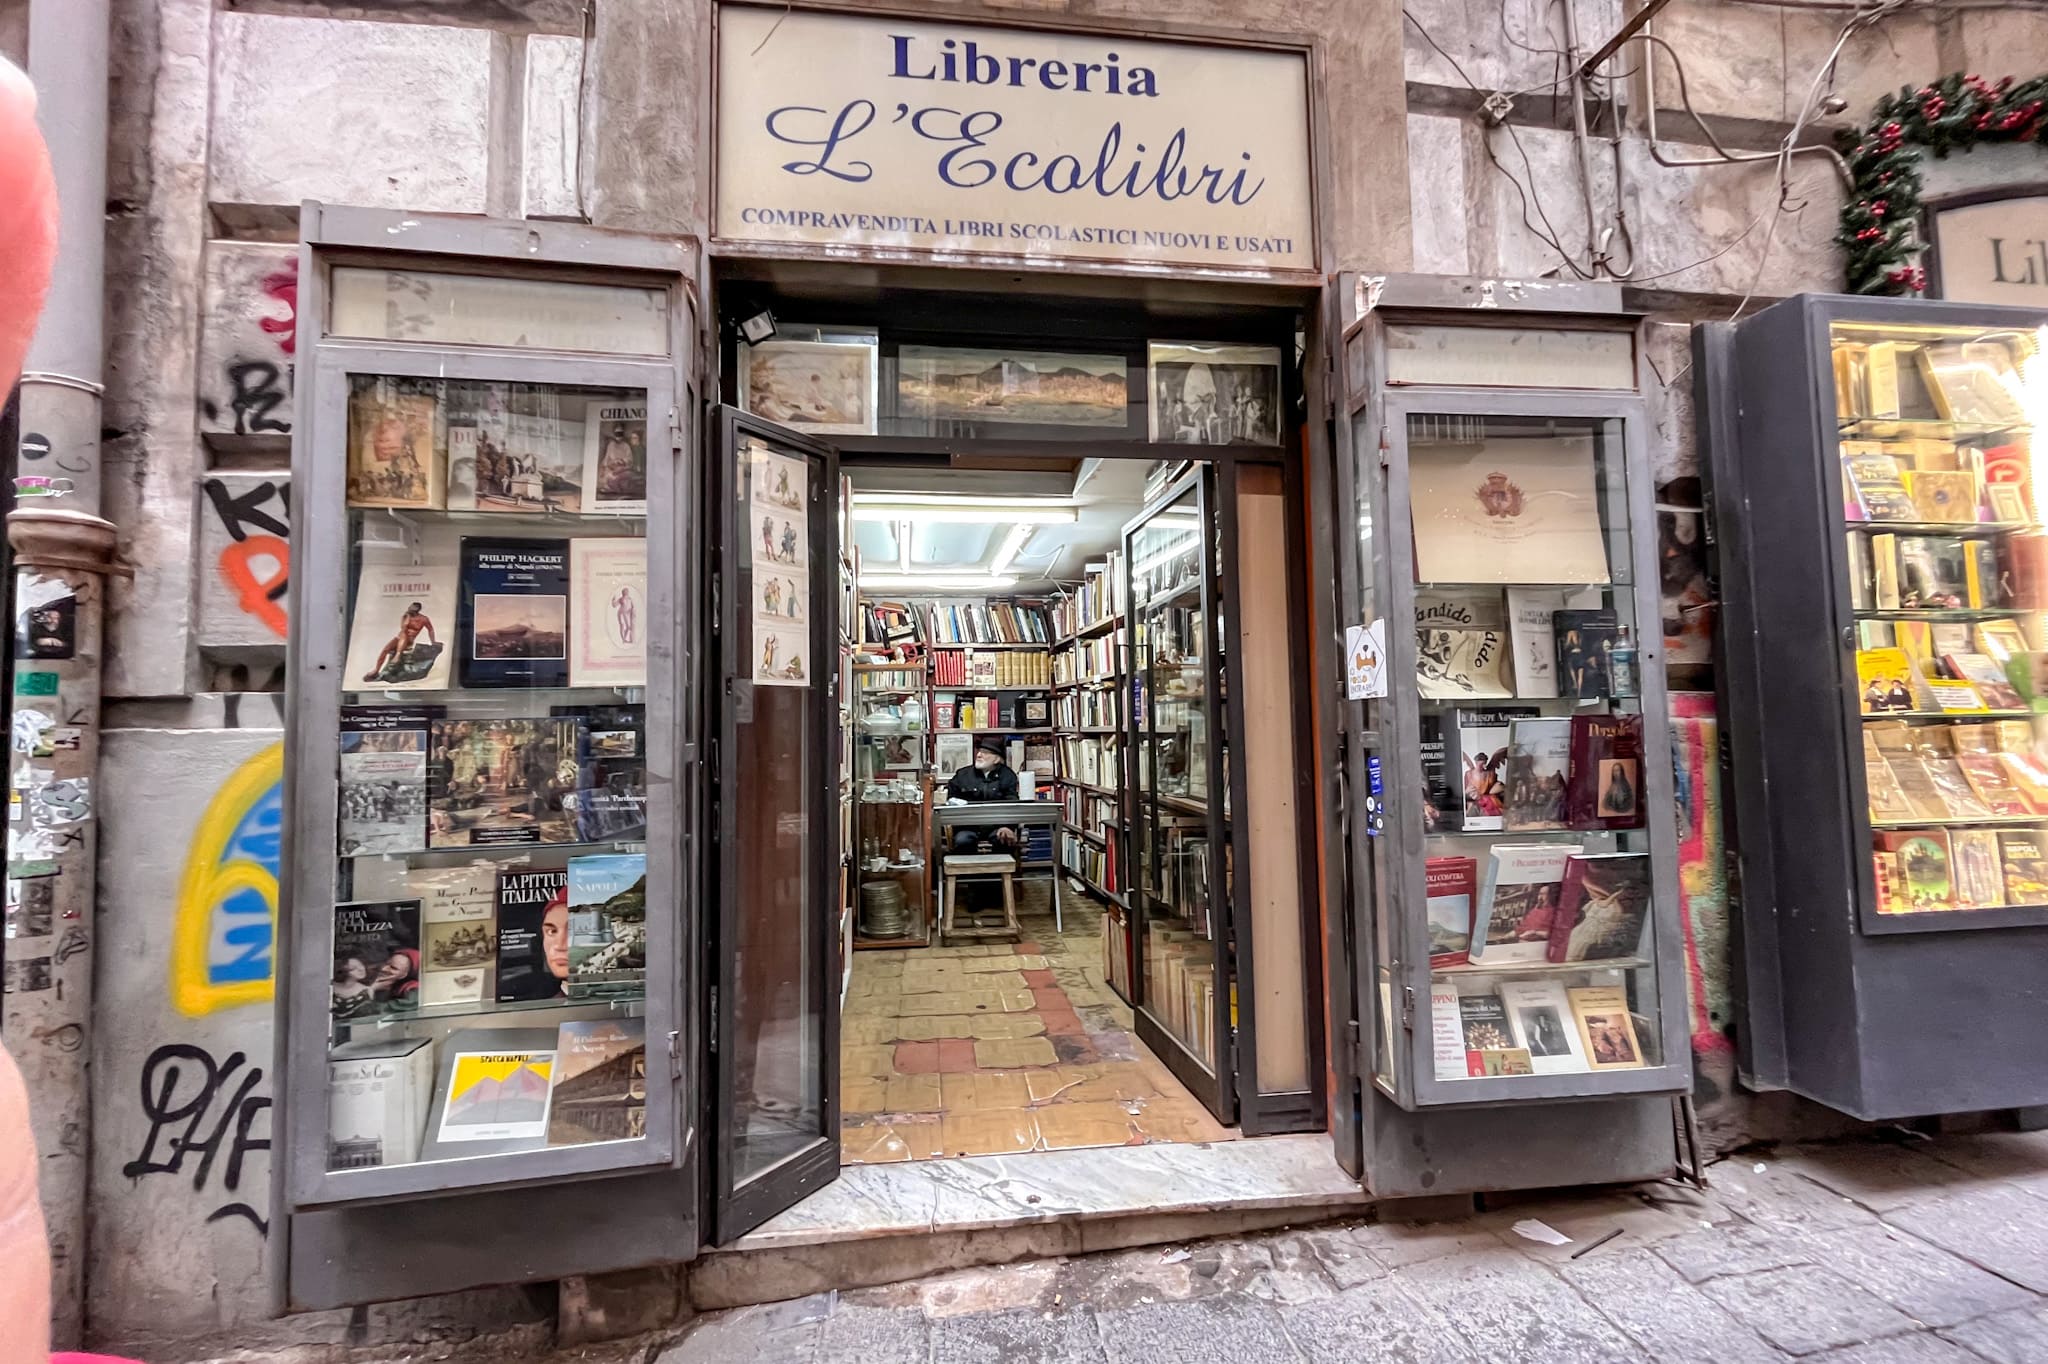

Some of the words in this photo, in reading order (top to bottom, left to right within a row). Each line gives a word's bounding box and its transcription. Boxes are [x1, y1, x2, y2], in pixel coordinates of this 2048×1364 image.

[888, 34, 1159, 97] Libreria
[765, 99, 1265, 206] L'Ecolibri
[741, 207, 937, 234] COMPRAVENDITA
[944, 219, 1004, 239] LIBRI
[1010, 223, 1137, 246] SCOLASTICI
[1144, 231, 1210, 250] NUOVI
[1216, 235, 1229, 251] E
[1235, 237, 1293, 254] USATI
[479, 554, 516, 563] PHILIPP
[519, 555, 563, 563] HACKERT
[1415, 602, 1472, 624] andido
[502, 875, 519, 890] LA
[502, 887, 559, 905] ITALIANA
